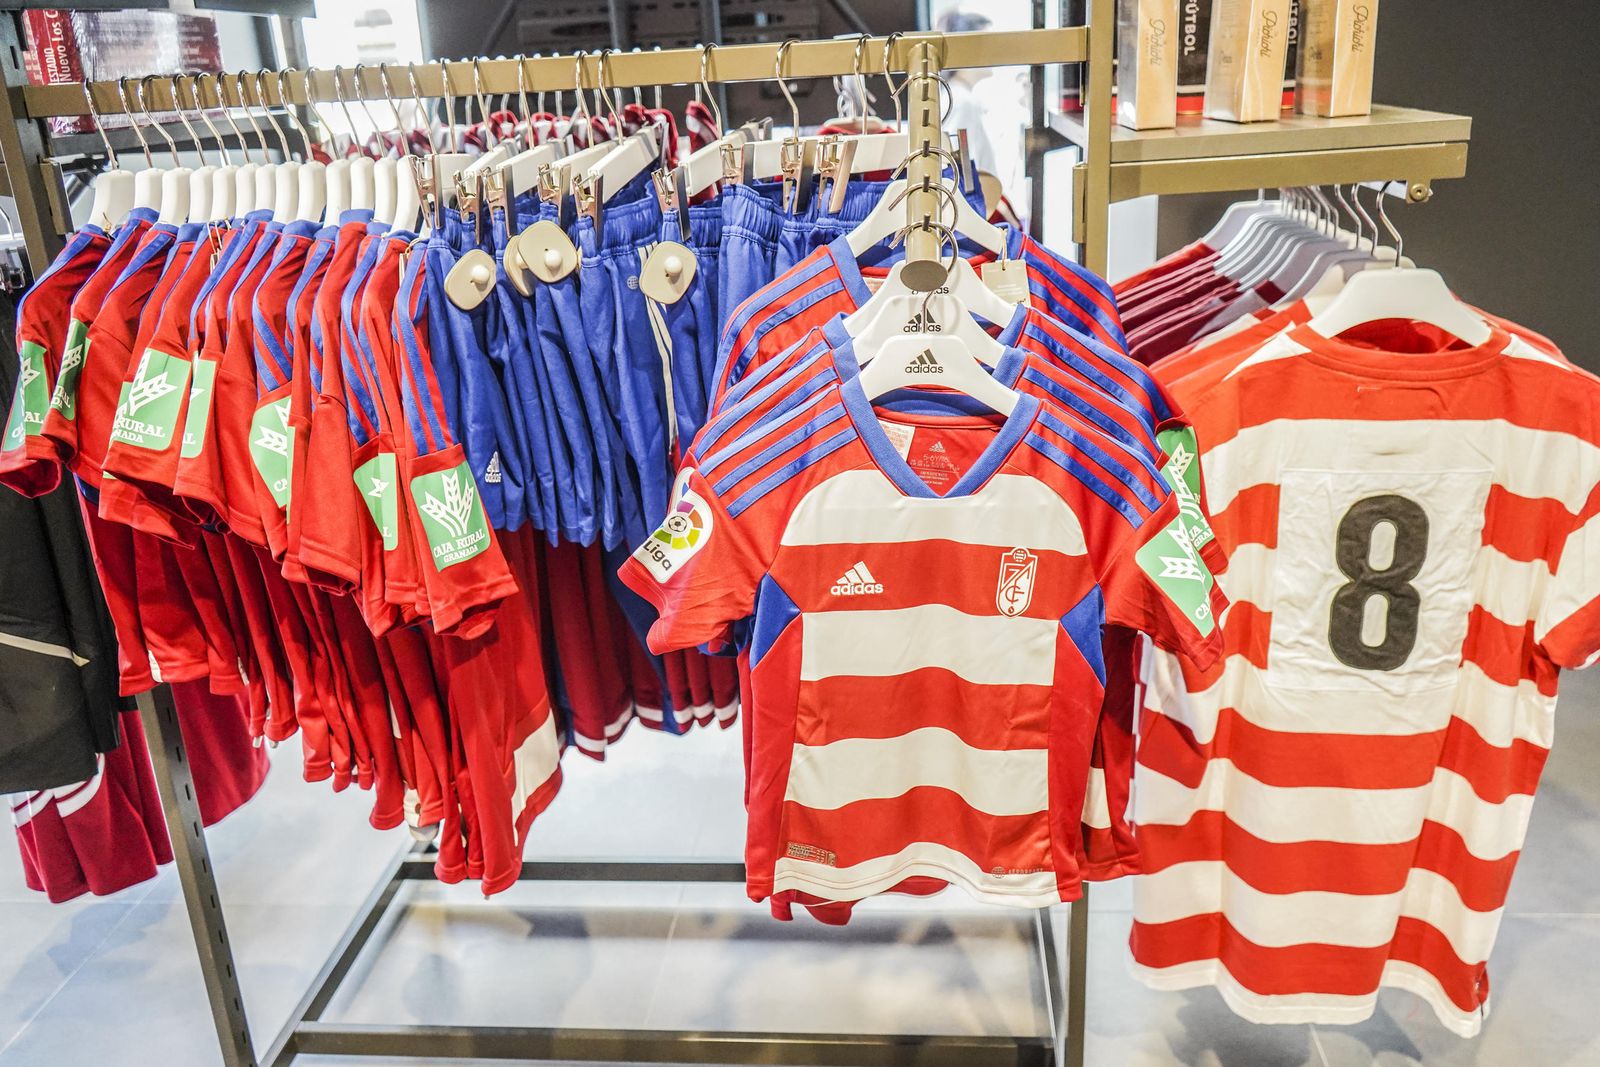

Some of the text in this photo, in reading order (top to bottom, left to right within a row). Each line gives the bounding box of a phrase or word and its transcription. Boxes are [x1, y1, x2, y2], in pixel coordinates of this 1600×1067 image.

[52, 21, 64, 42] Los
[44, 47, 60, 83] ESTADIO
[57, 45, 72, 82] Nuevo
[903, 323, 942, 333] adias
[904, 364, 944, 374] adidas
[456, 529, 485, 550] RURAL
[643, 540, 672, 571] Liga
[830, 582, 884, 596] adidas
[1328, 494, 1429, 671] 8
